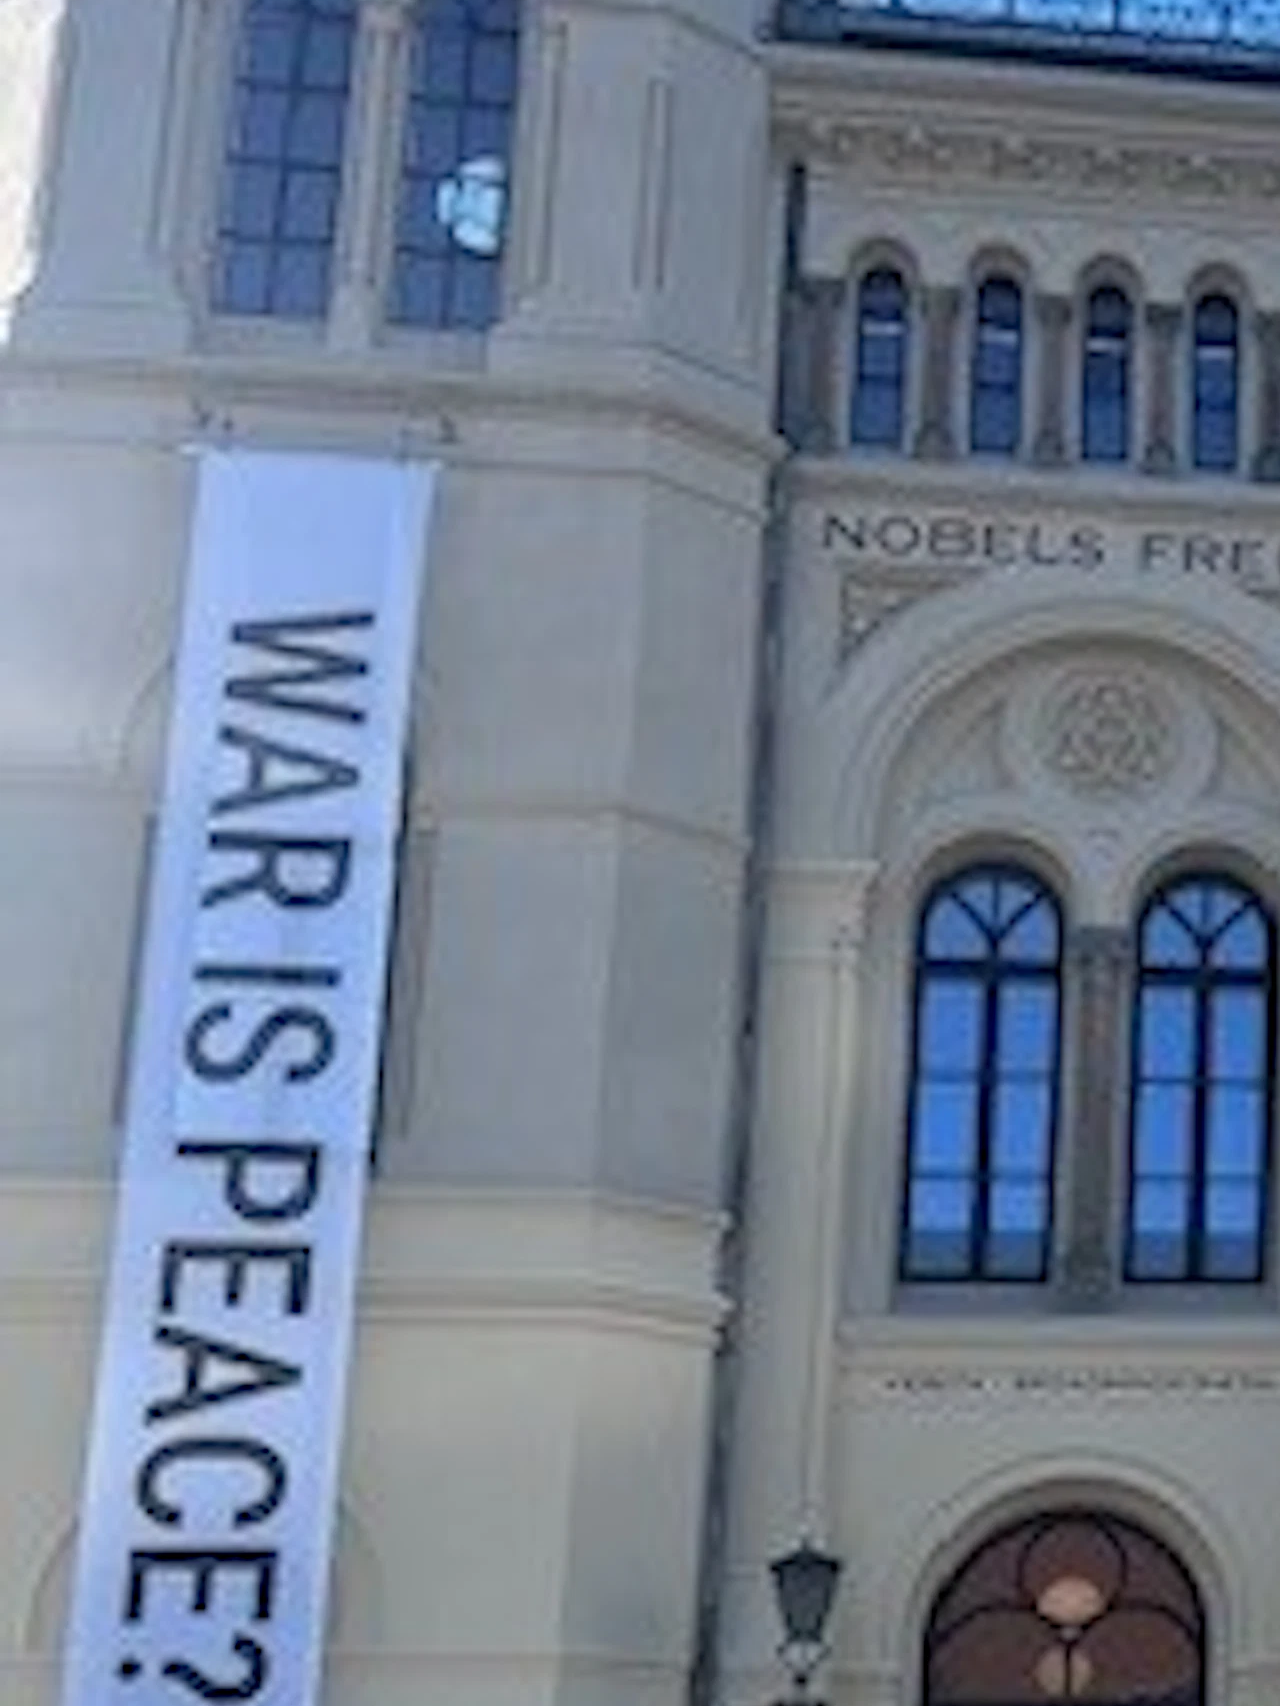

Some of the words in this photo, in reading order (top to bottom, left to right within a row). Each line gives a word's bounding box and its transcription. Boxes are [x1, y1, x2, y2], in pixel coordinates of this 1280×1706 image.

[821, 512, 1107, 569] NOBELS
[199, 610, 376, 909] WAR
[183, 964, 342, 1084] IS
[117, 1140, 321, 1706] PEACE?
